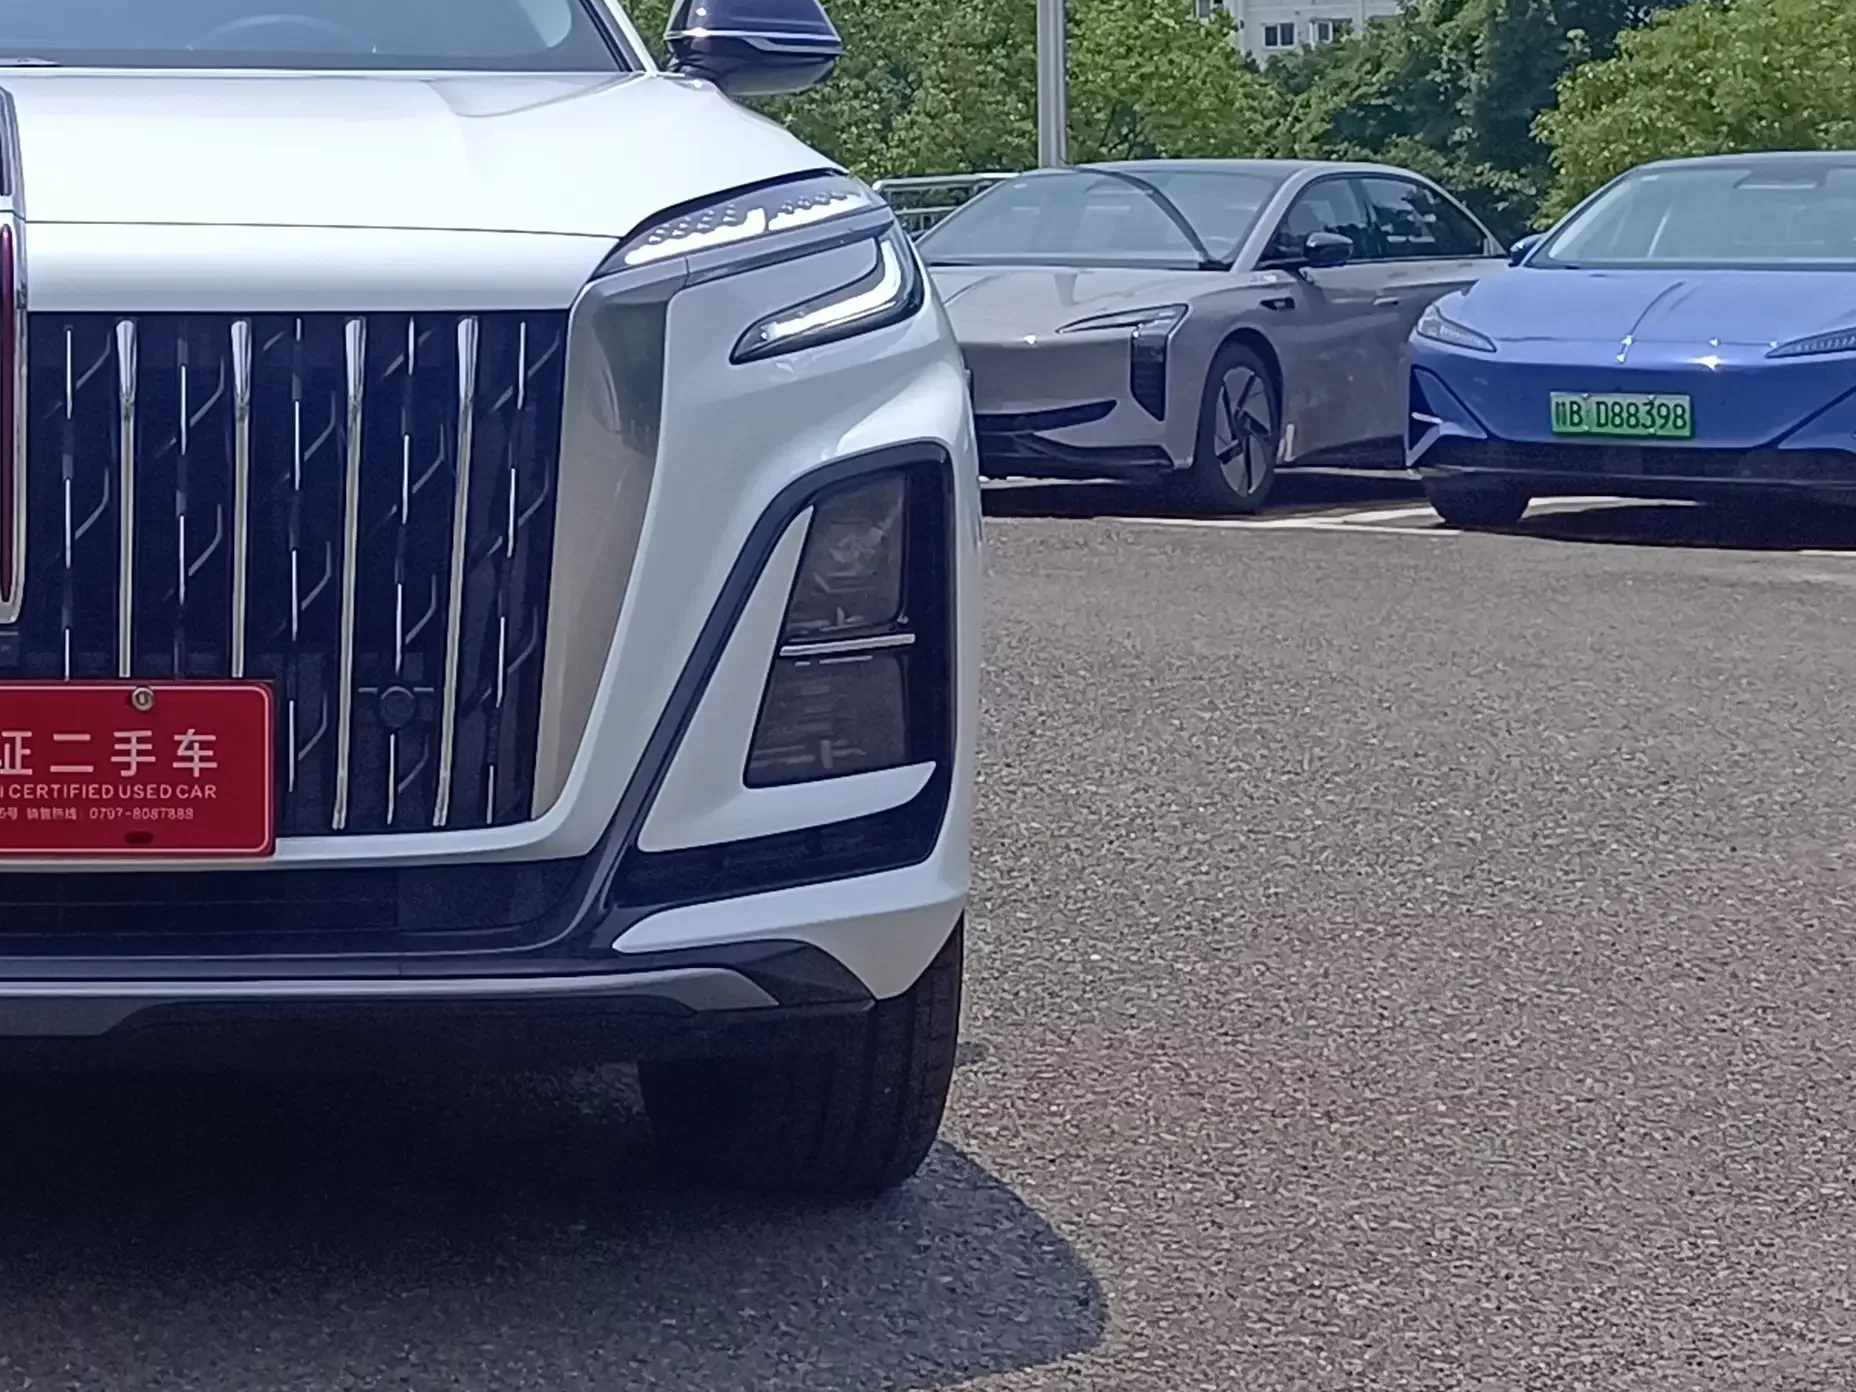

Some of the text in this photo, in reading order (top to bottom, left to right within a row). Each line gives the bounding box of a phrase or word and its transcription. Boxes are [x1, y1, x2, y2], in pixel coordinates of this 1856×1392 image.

[1595, 401, 1687, 430] D88398
[8, 783, 114, 800] CERTIFIED
[118, 783, 172, 800] USED
[175, 783, 218, 800] CAR
